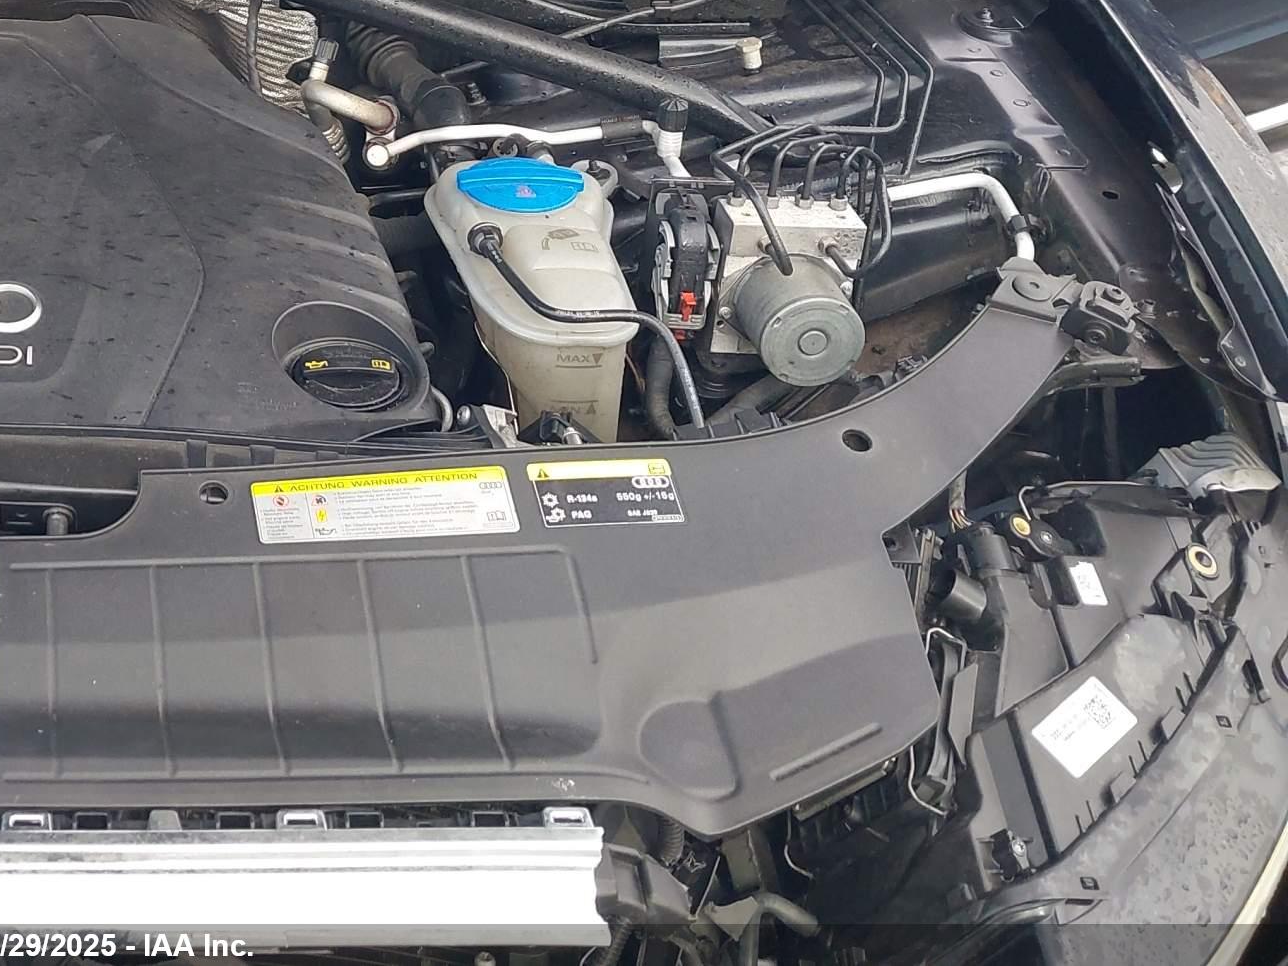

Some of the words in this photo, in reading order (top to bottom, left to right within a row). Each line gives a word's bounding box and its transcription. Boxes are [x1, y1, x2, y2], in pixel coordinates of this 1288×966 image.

[556, 353, 590, 363] MAX
[289, 481, 345, 491] ACHTUNG
[351, 477, 408, 487] WARNING
[415, 472, 479, 483] ATTENTION
[566, 493, 598, 504] R-134a
[571, 509, 592, 520] PAG
